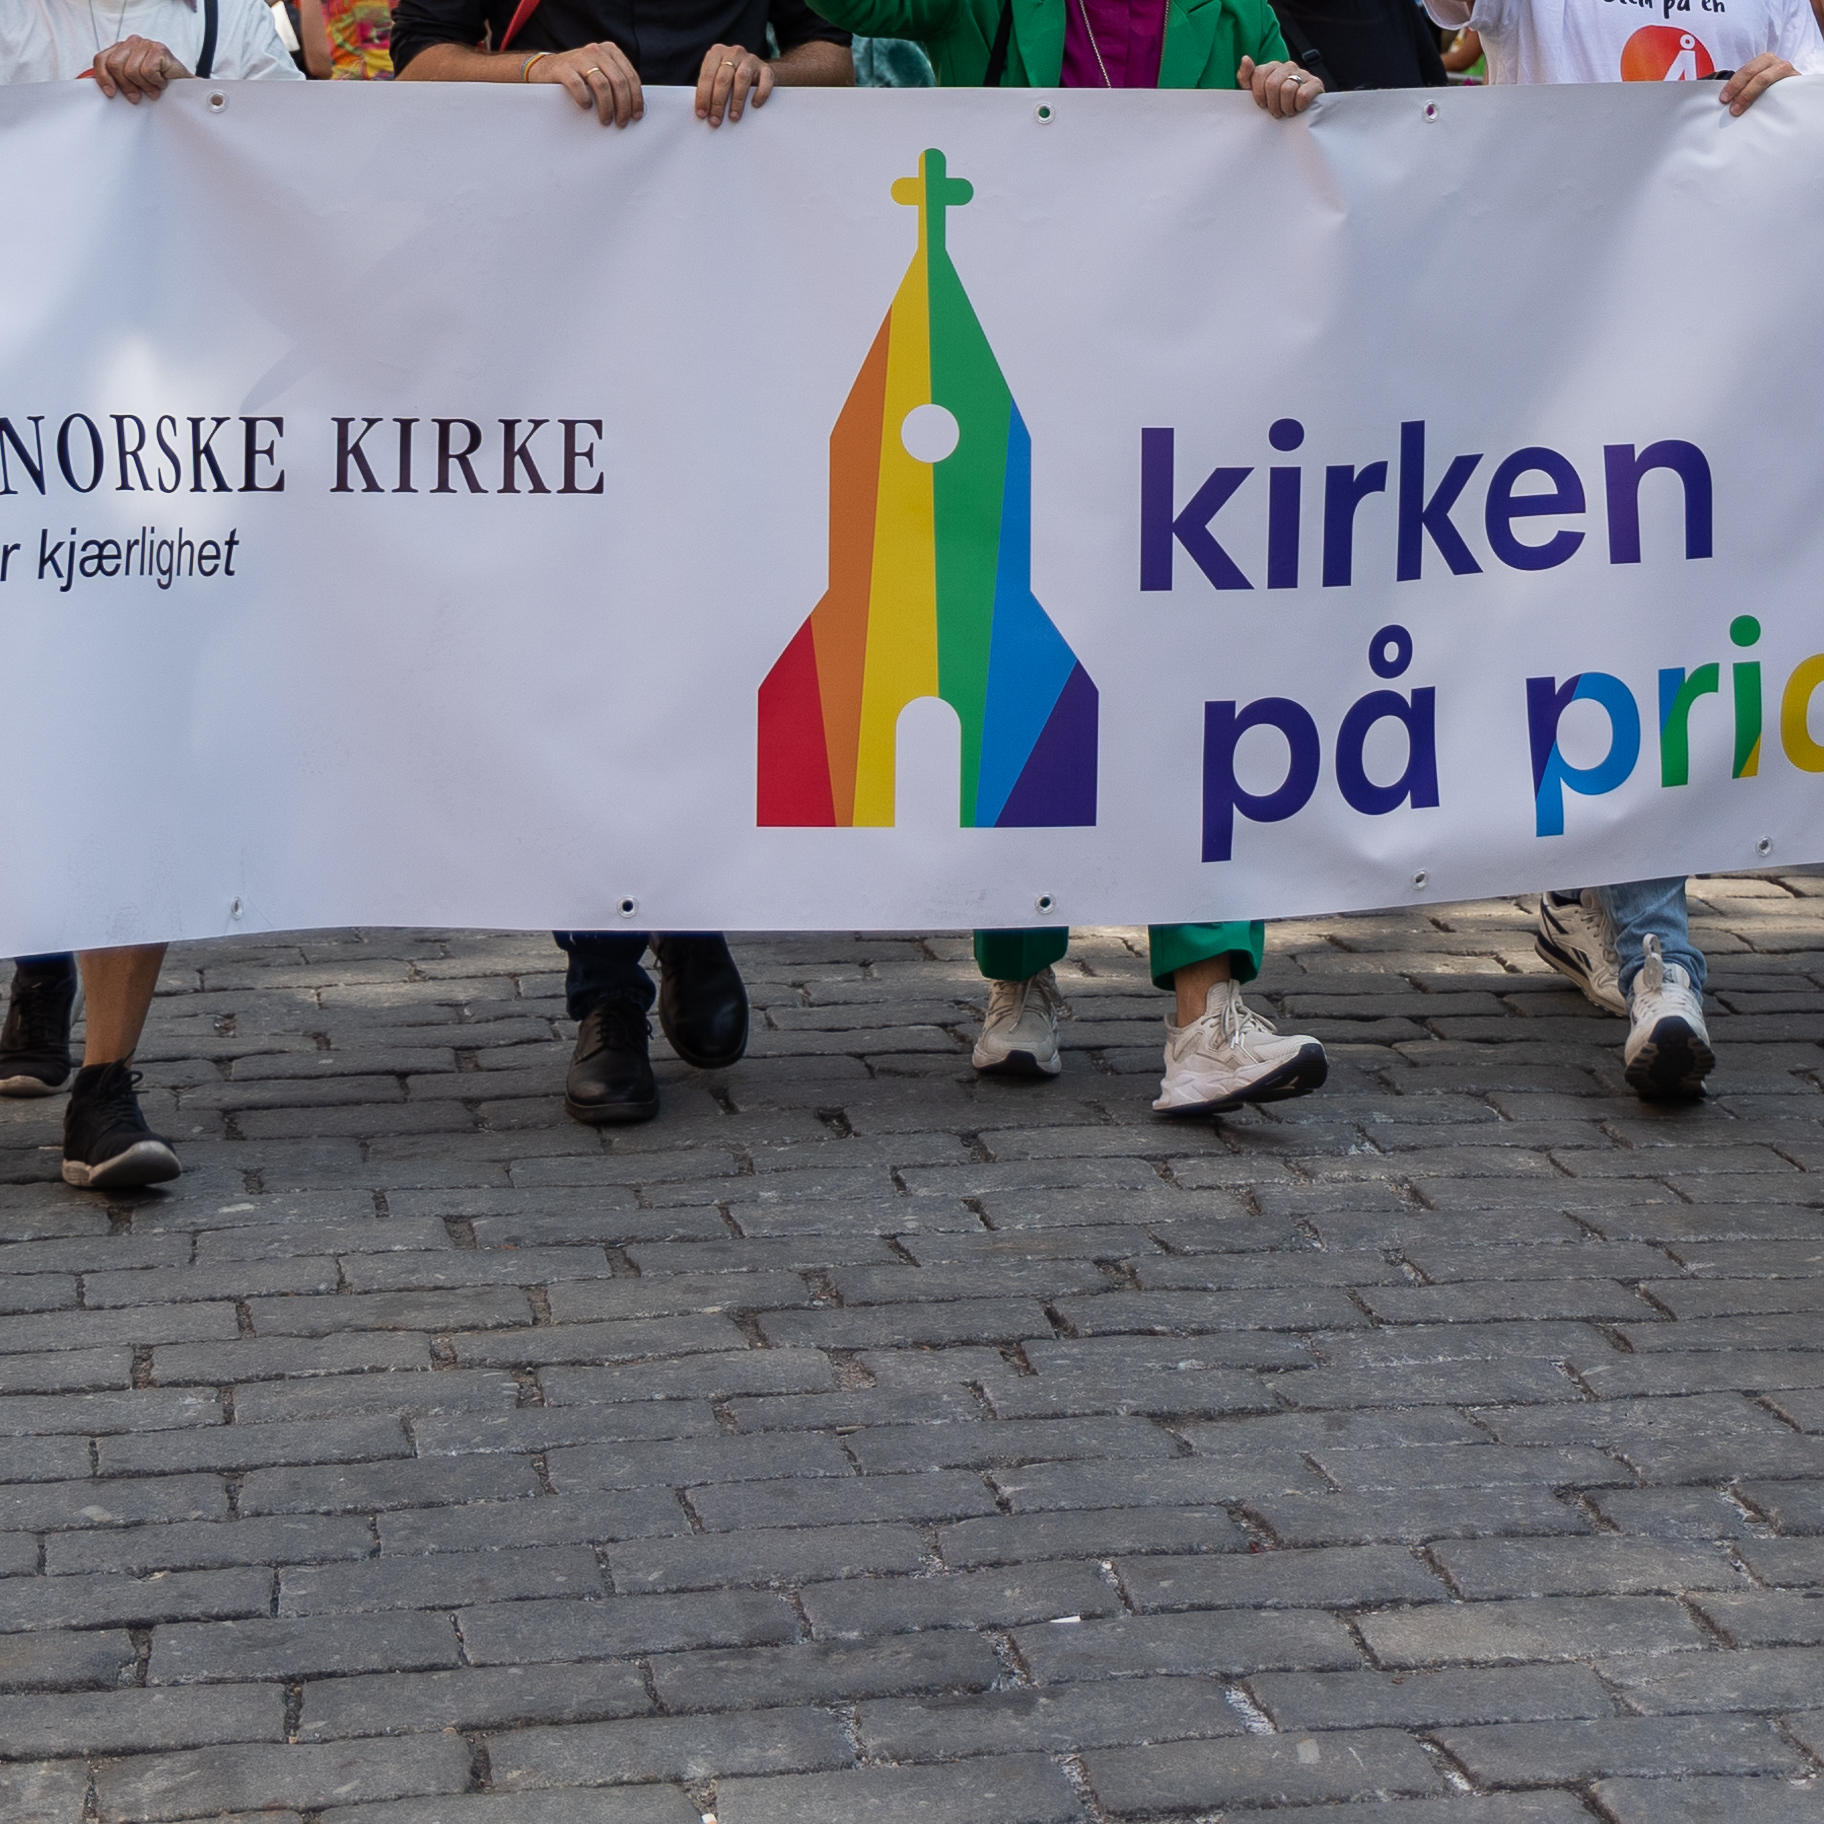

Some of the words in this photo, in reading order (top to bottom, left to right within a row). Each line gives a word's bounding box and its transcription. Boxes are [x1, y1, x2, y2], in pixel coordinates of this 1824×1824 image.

[329, 417, 605, 495] KIRKE
[1139, 418, 1714, 592] kirken
[37, 526, 240, 592] kjærlighet
[1201, 624, 1440, 863] på
